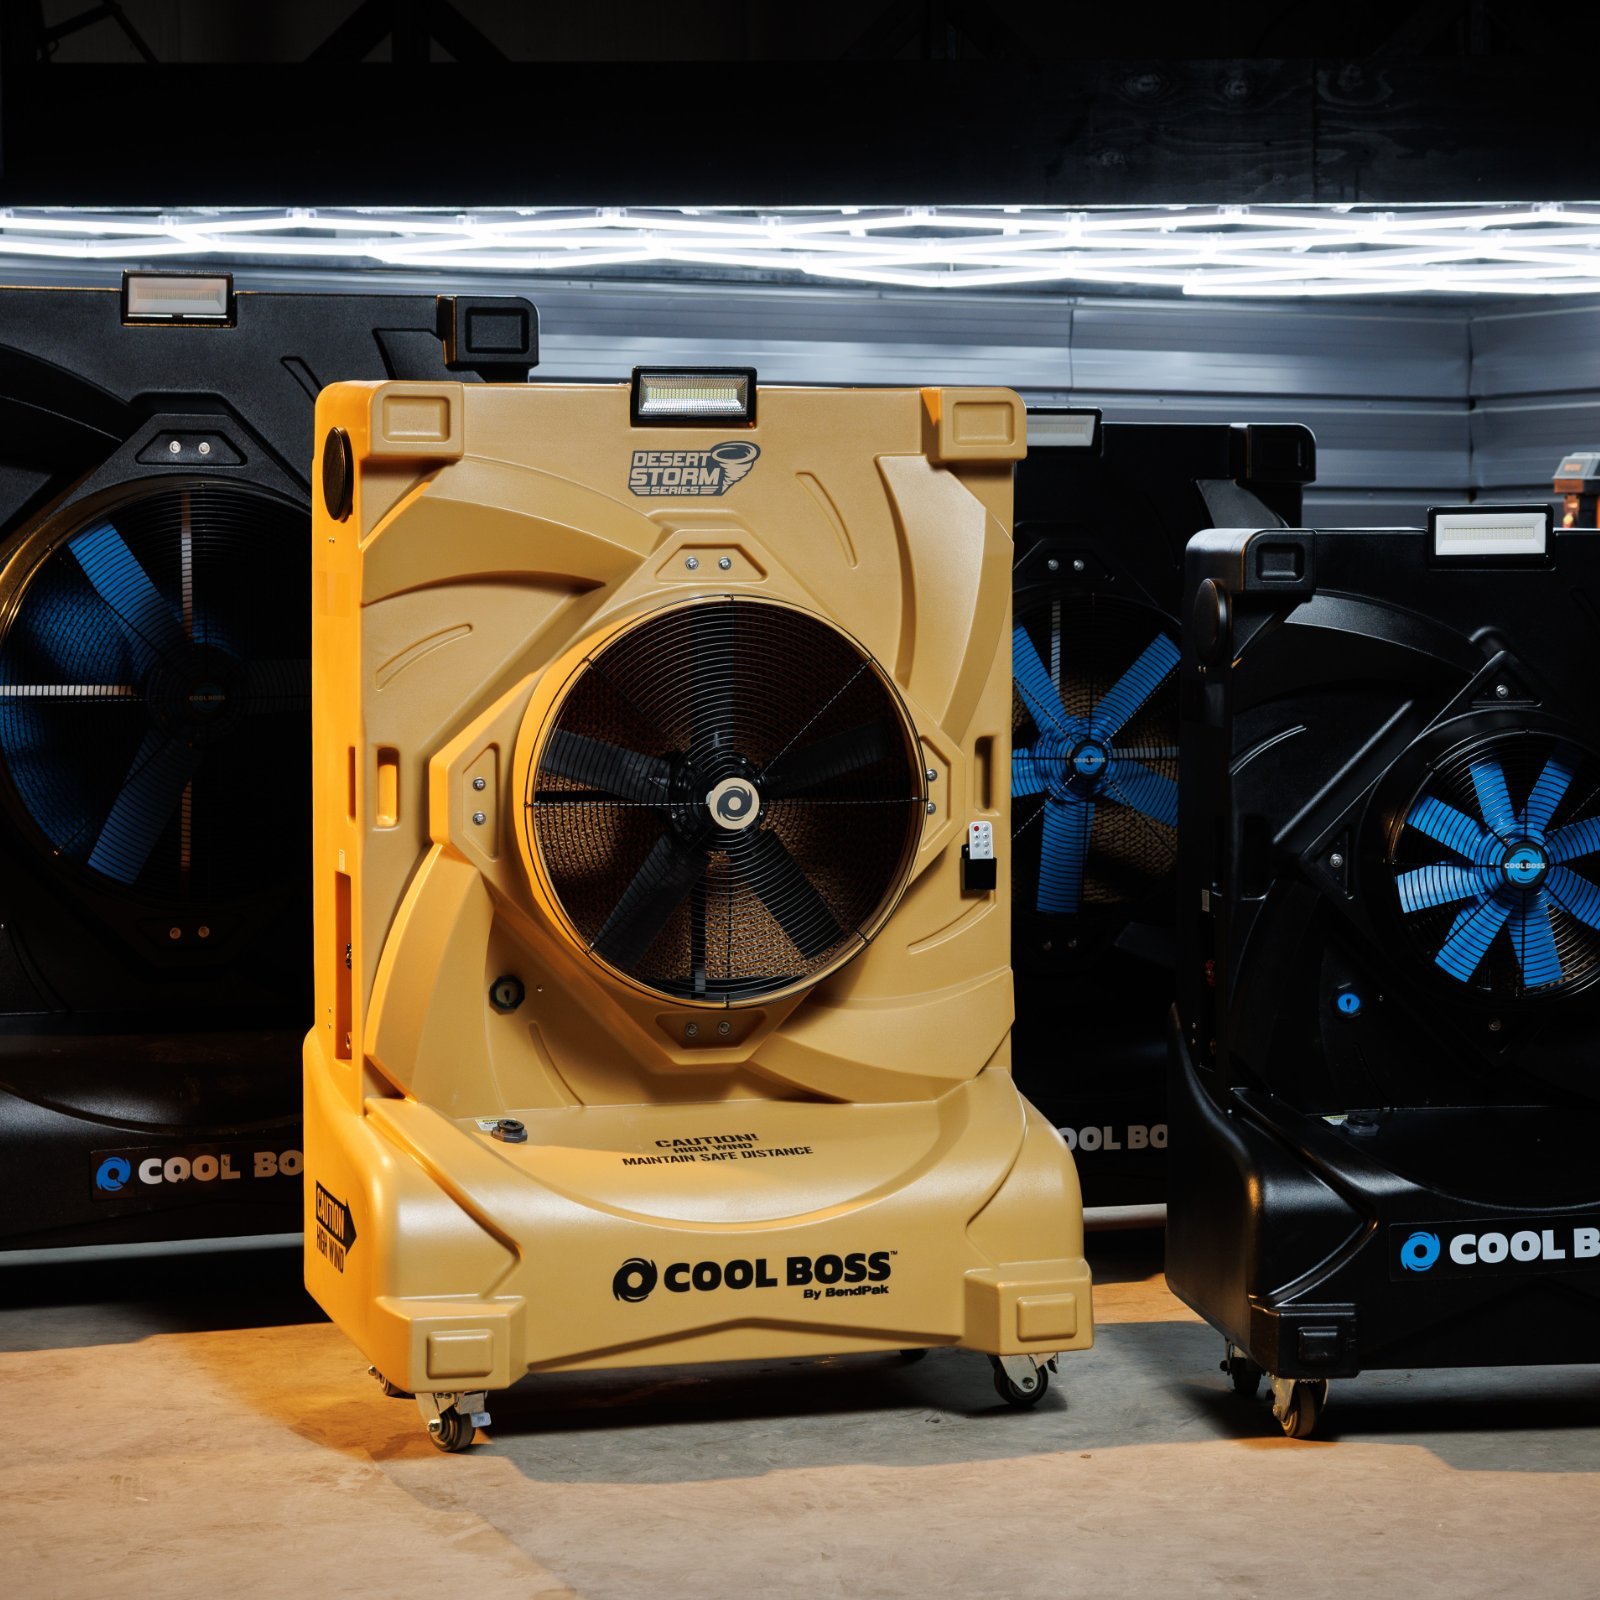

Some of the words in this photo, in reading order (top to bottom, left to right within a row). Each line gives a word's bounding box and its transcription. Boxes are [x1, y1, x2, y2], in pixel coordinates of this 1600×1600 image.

[633, 452, 712, 467] DESERT
[629, 467, 721, 486] STORM
[650, 486, 699, 495] SERIES
[655, 1133, 760, 1148] CAUTION!
[672, 1145, 709, 1153] HIGH
[713, 1142, 754, 1151] WIND
[622, 1155, 696, 1166] MAINTAIN
[700, 1151, 738, 1162] SAFE
[742, 1146, 814, 1159] DISTANCE
[138, 1153, 241, 1185] COOL
[317, 1187, 345, 1240] CAUTION
[316, 1223, 328, 1259] HIGH
[328, 1236, 344, 1274] WIND
[1449, 1229, 1566, 1265] COOL
[664, 1258, 778, 1293] COOL
[803, 1289, 821, 1301] By
[825, 1284, 890, 1298] BendPak
